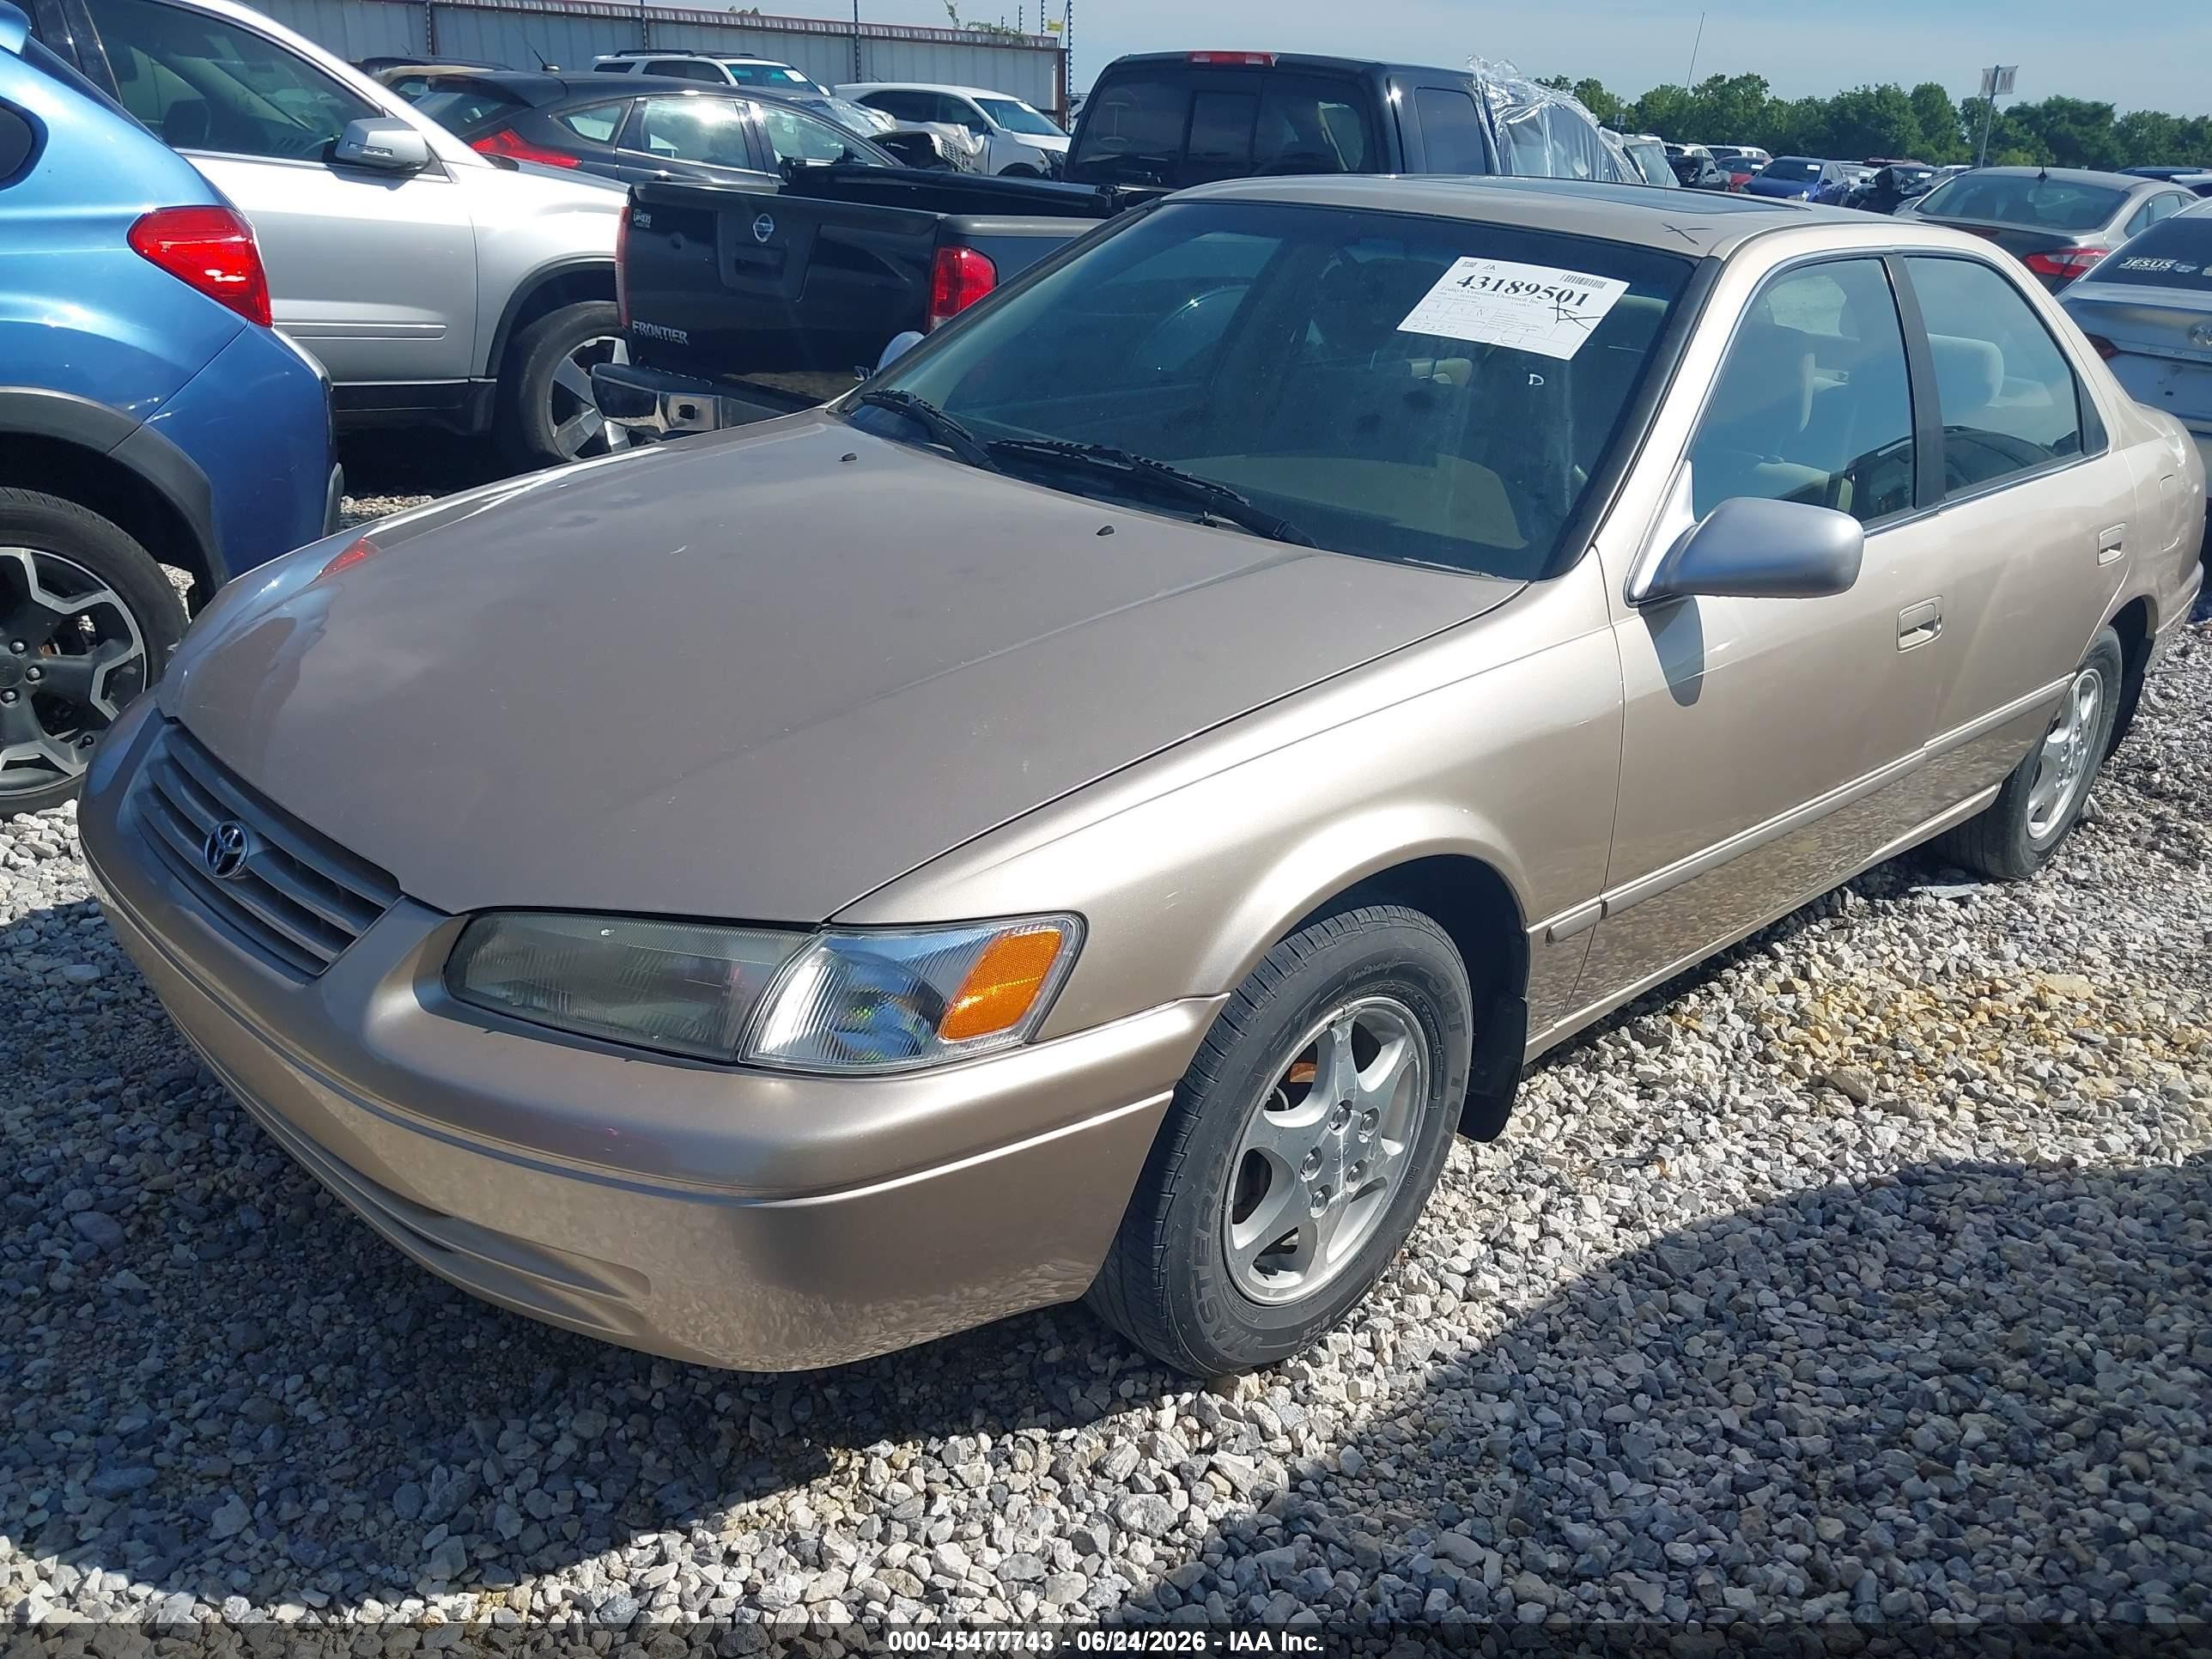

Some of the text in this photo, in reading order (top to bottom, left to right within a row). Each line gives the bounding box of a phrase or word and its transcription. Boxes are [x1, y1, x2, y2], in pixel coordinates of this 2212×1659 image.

[1999, 70, 2014, 90] M
[2121, 257, 2177, 269] JESUS
[1455, 273, 1590, 307] 43189501
[632, 319, 690, 346] FRONTIER
[1528, 373, 1545, 386] D
